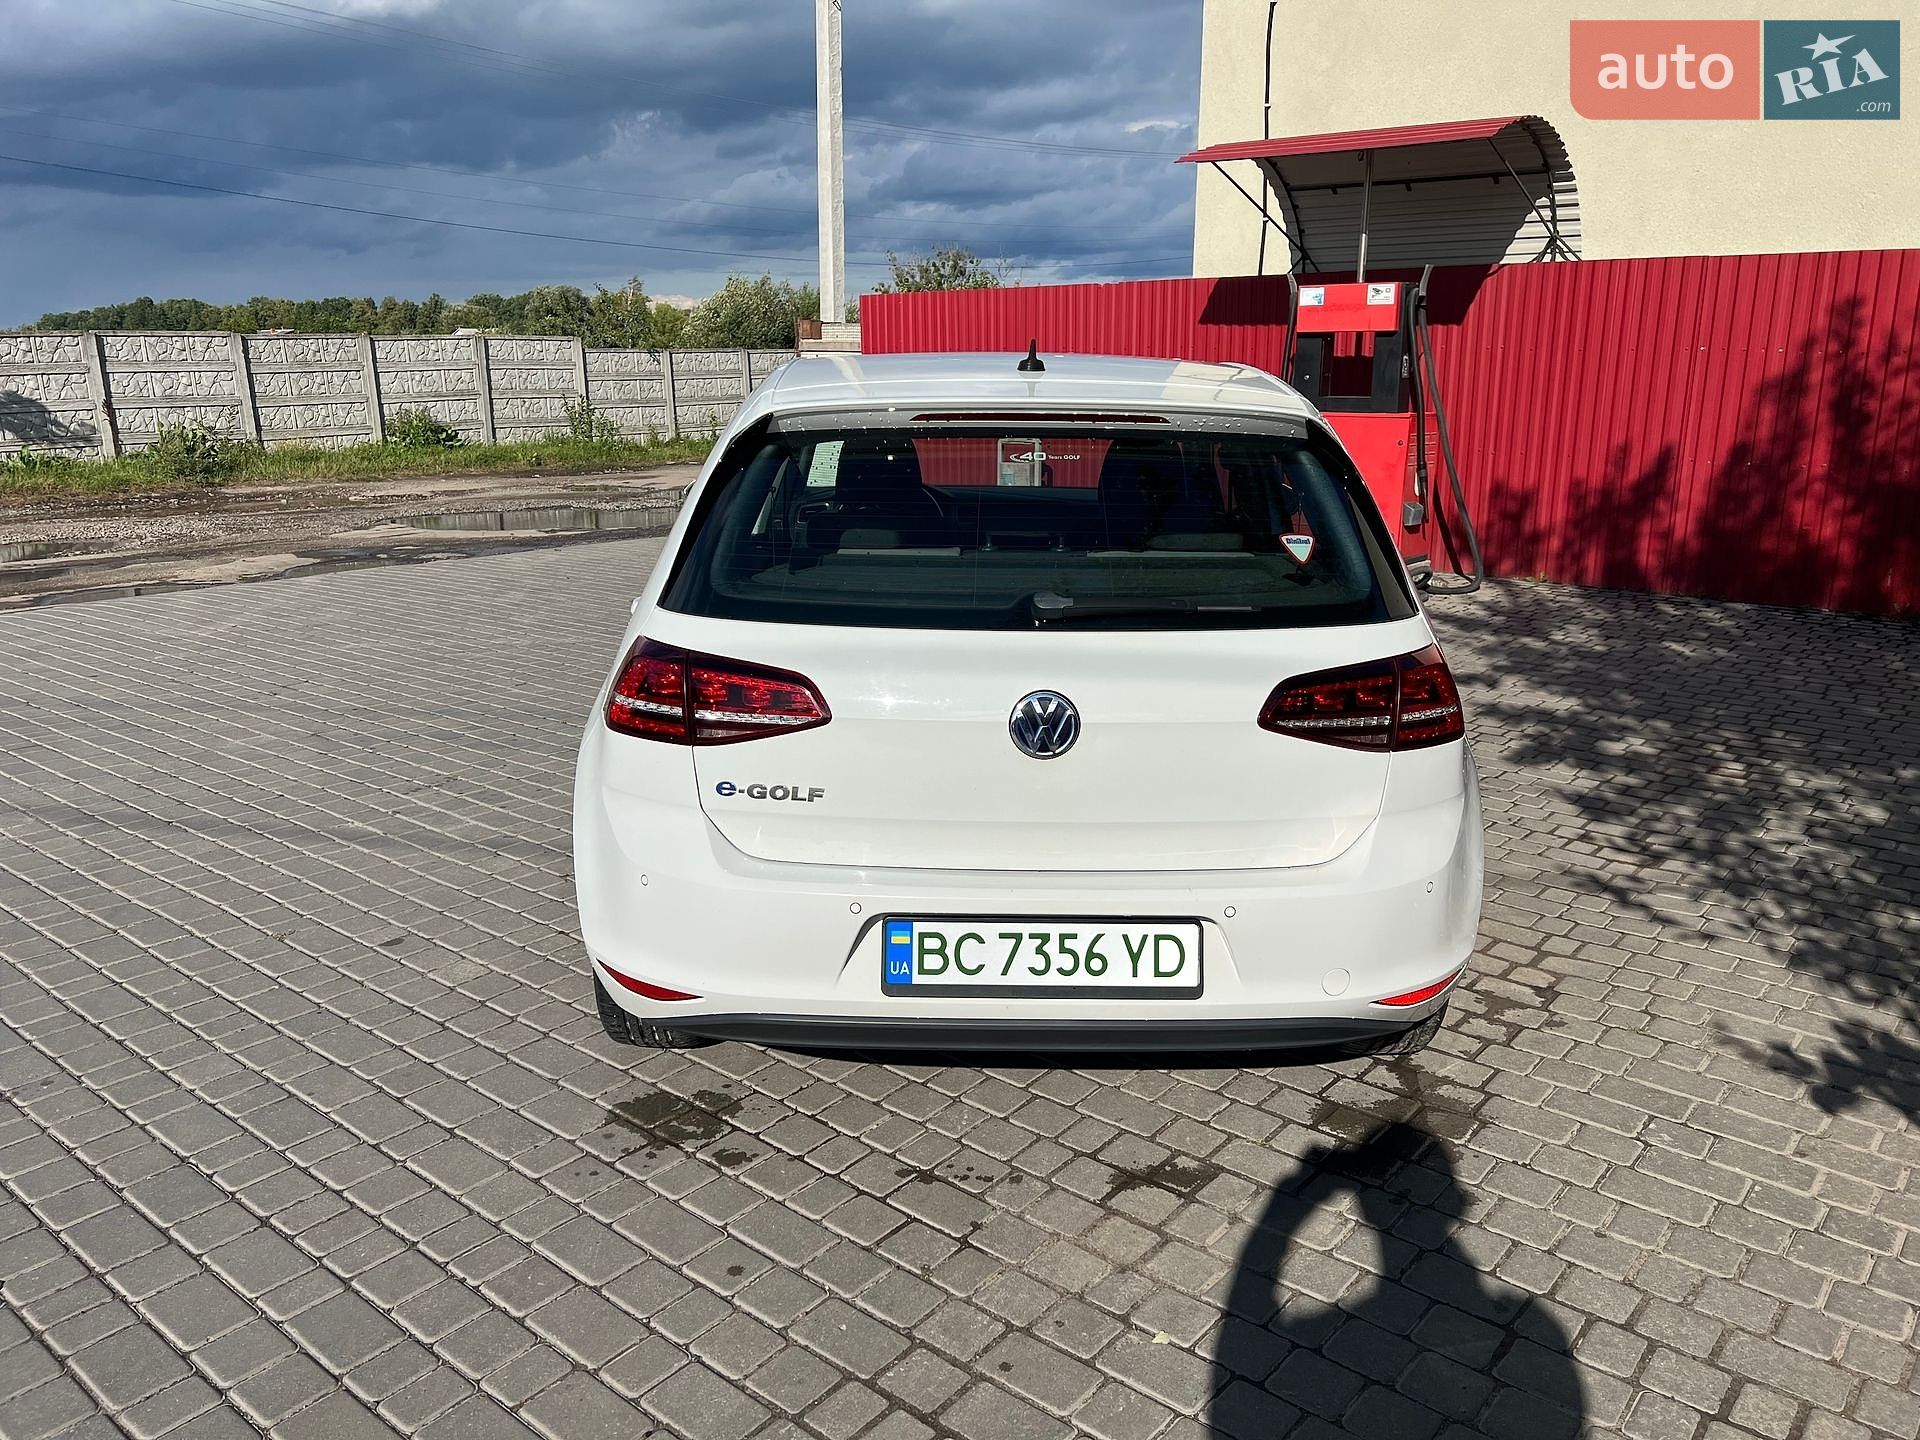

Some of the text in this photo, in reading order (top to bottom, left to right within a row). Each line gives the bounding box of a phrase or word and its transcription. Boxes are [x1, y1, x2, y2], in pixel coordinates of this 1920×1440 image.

[715, 781, 825, 802] e-GOLF
[917, 931, 1186, 978] BC 7356 YD
[890, 962, 911, 976] UA
